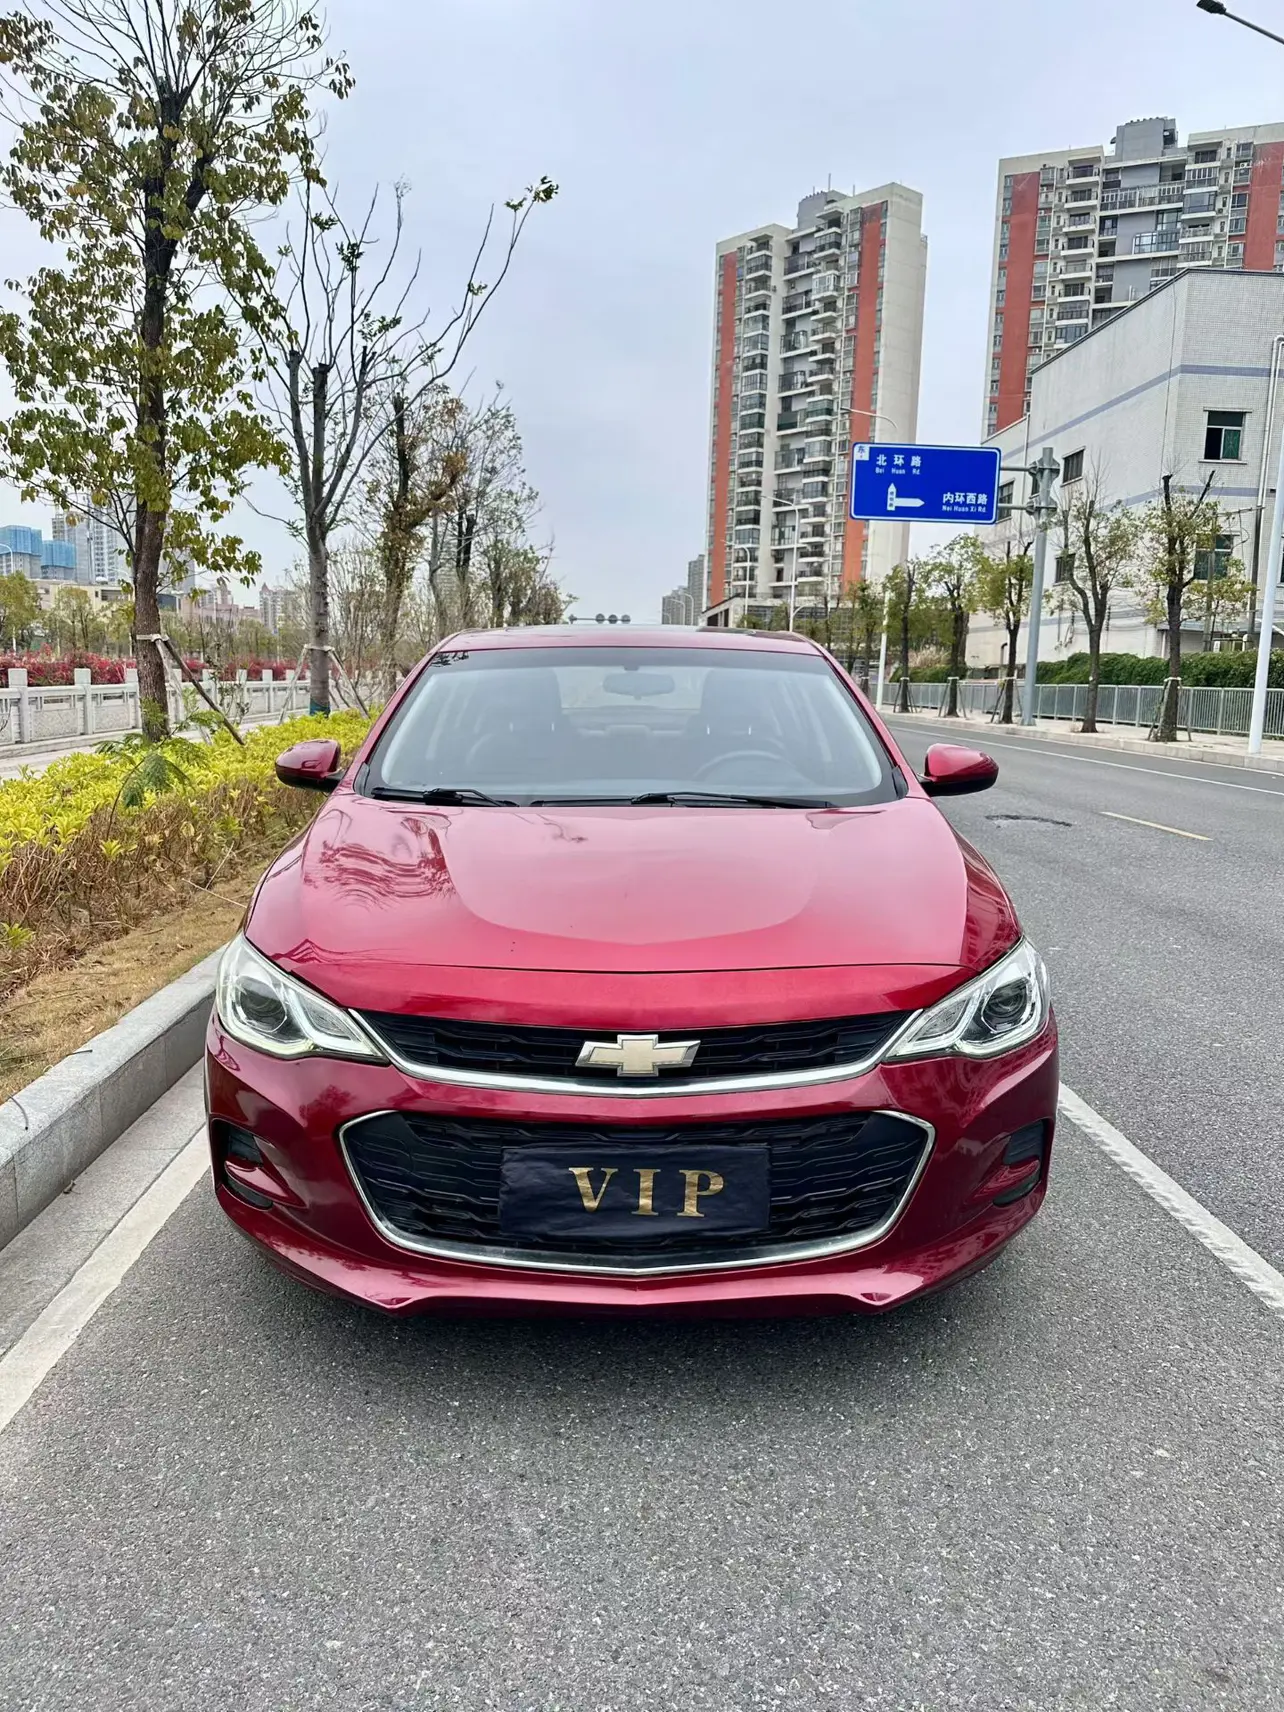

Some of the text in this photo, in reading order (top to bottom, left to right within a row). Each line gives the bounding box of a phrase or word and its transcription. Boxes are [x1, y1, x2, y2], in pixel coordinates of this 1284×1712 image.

[876, 454, 921, 467] 北环路
[891, 467, 906, 475] Huan
[942, 492, 988, 505] 内环西路
[568, 1166, 724, 1217] VIP
